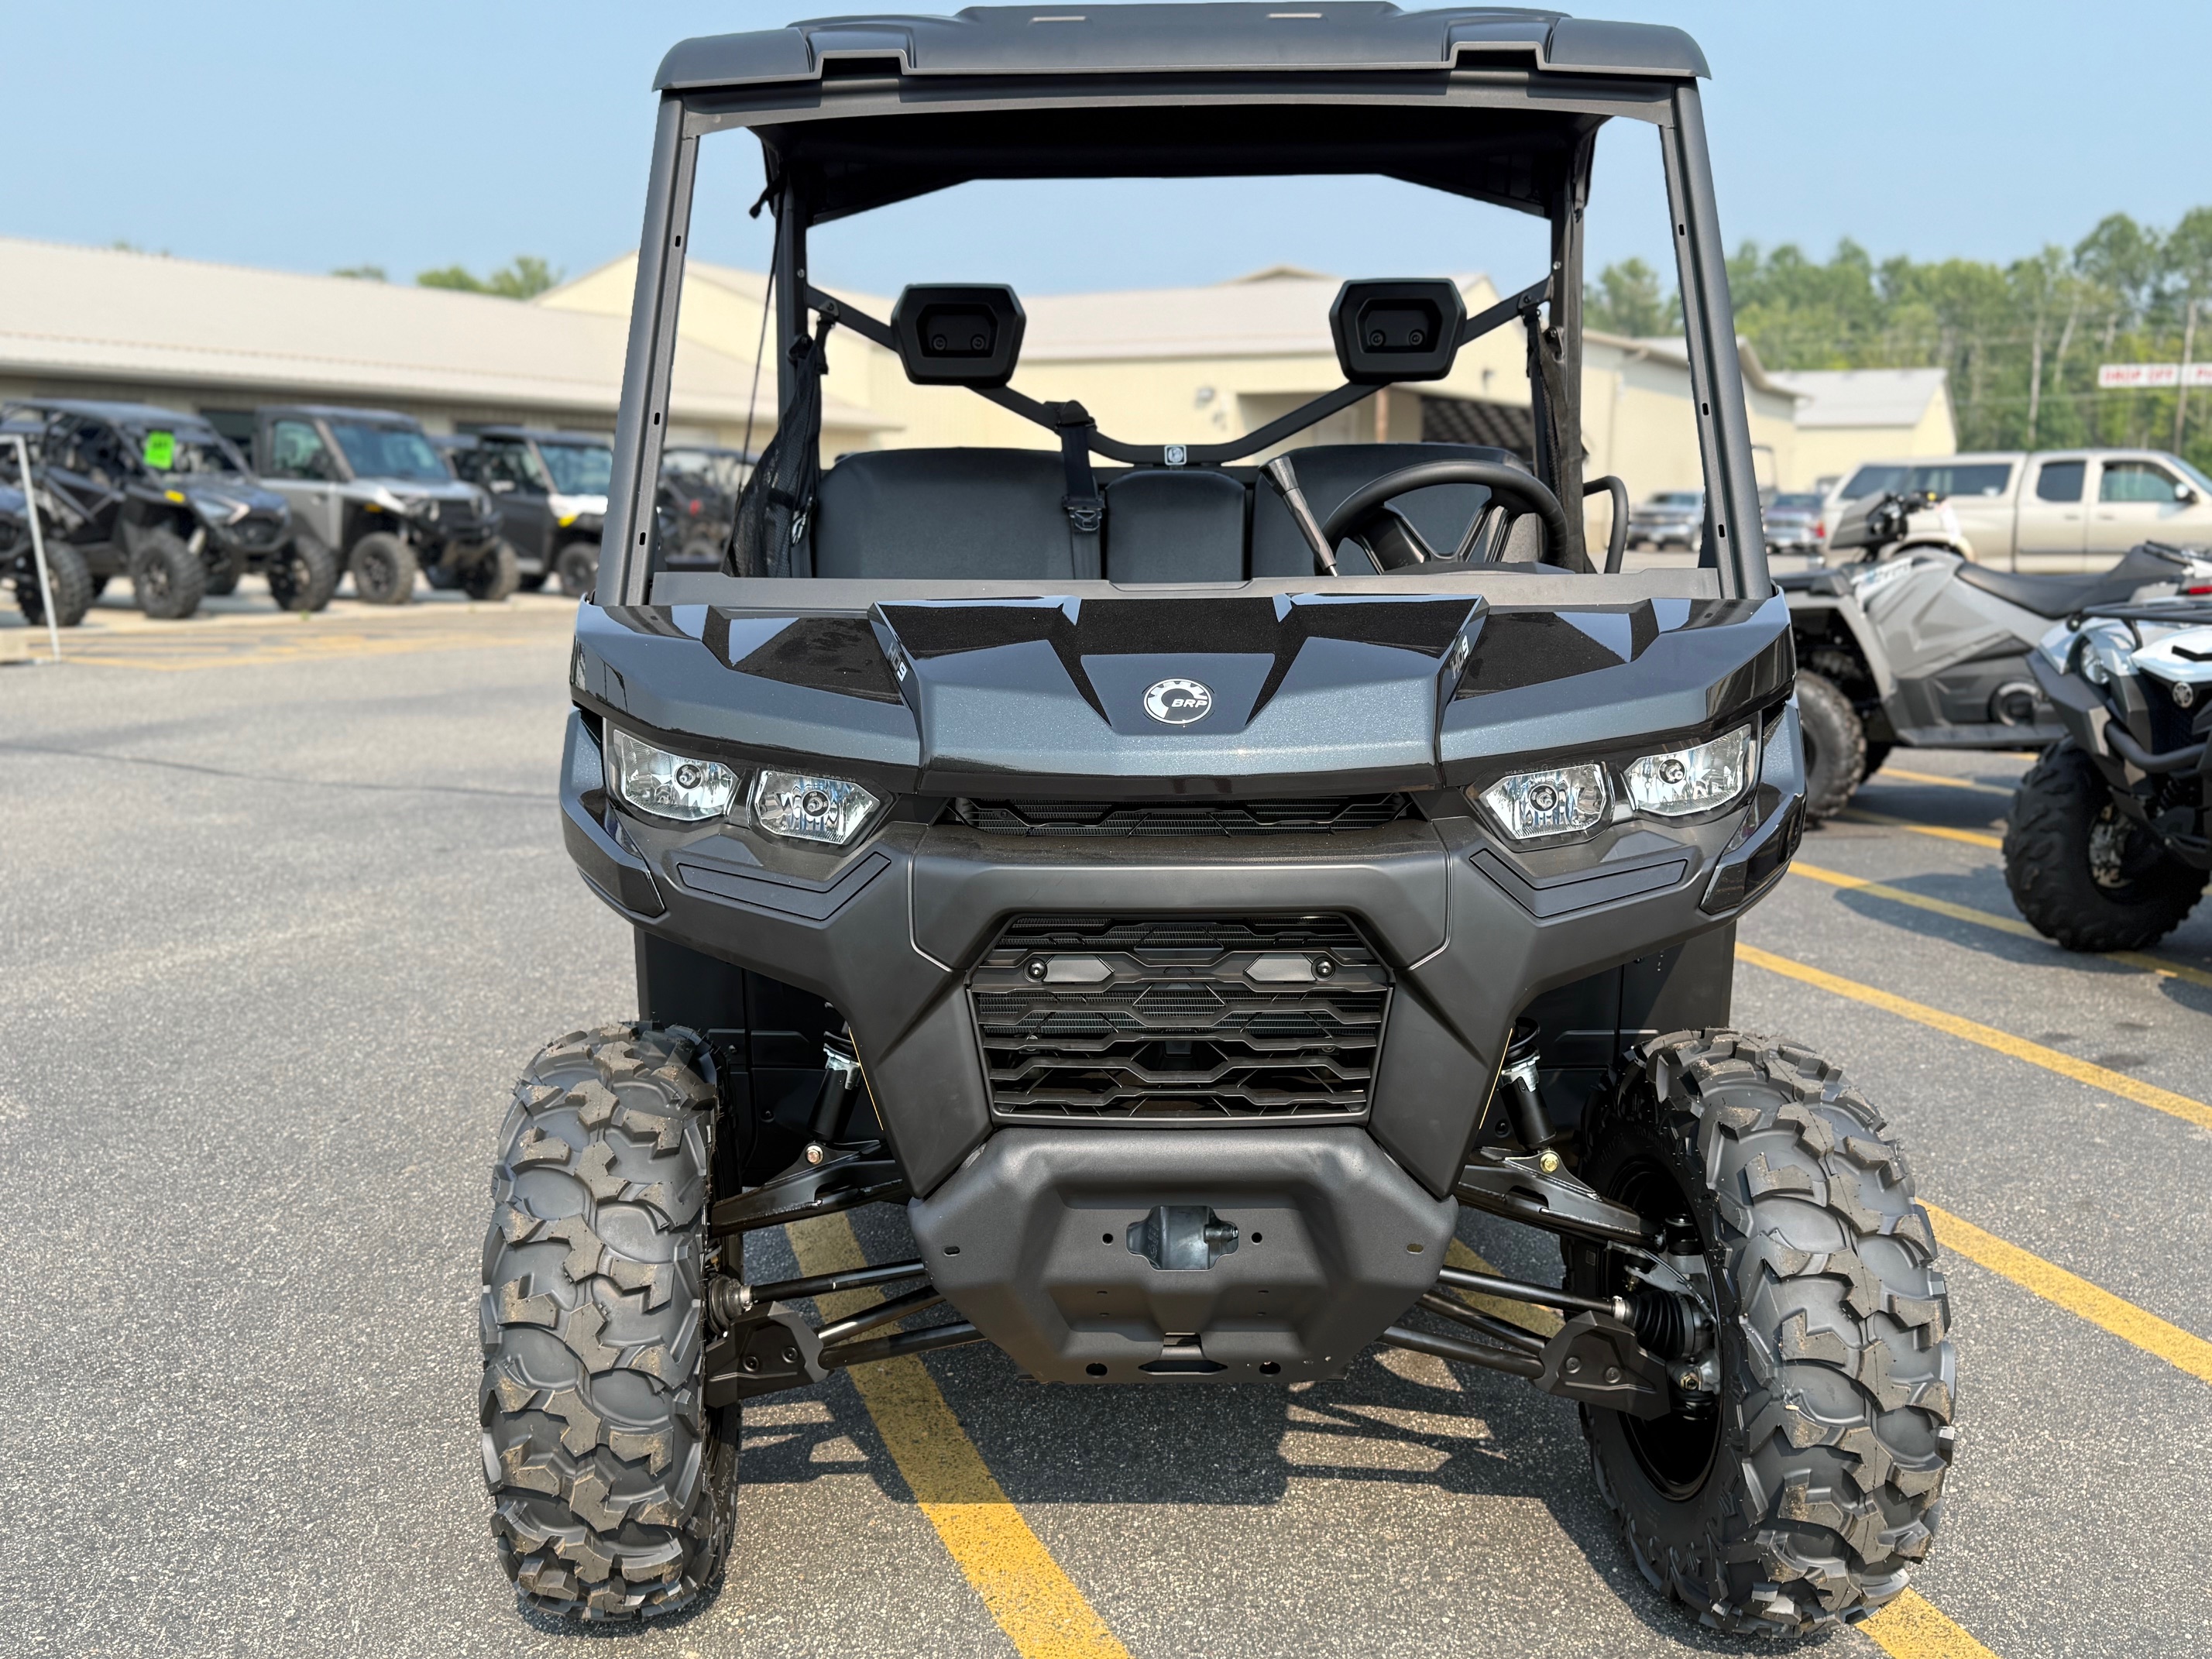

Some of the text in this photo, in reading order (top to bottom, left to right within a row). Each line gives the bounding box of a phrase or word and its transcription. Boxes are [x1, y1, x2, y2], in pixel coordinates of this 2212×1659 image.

[888, 642, 907, 682] HD9
[1451, 635, 1468, 680] HD9
[1171, 699, 1207, 708] BRP
